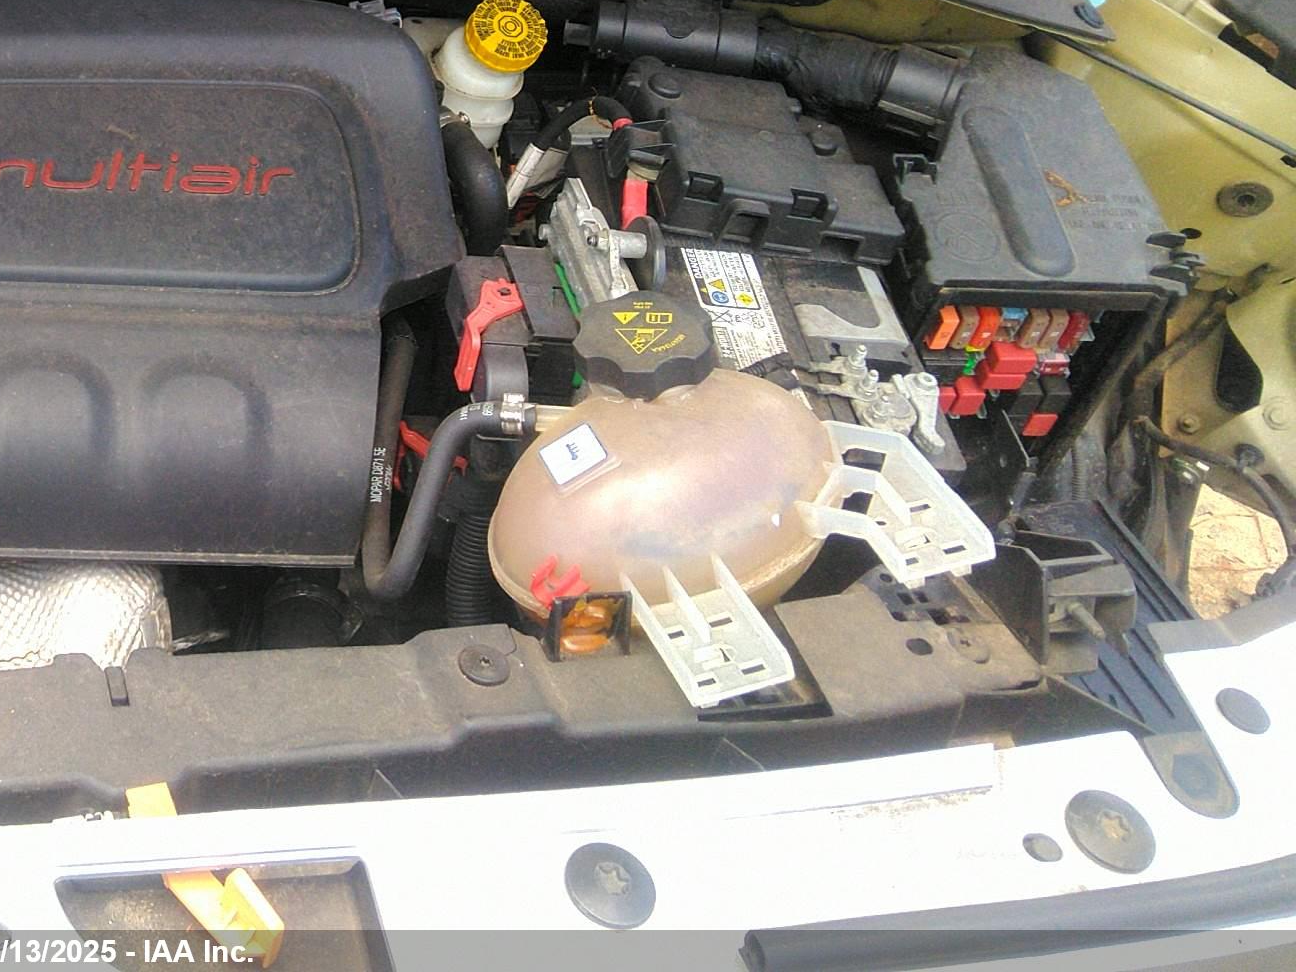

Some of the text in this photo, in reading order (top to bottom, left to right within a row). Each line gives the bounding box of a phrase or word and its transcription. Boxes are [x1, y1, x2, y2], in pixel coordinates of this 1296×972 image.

[684, 247, 704, 279] DANGER
[371, 457, 386, 476] D871
[369, 476, 384, 504] MOPAR
